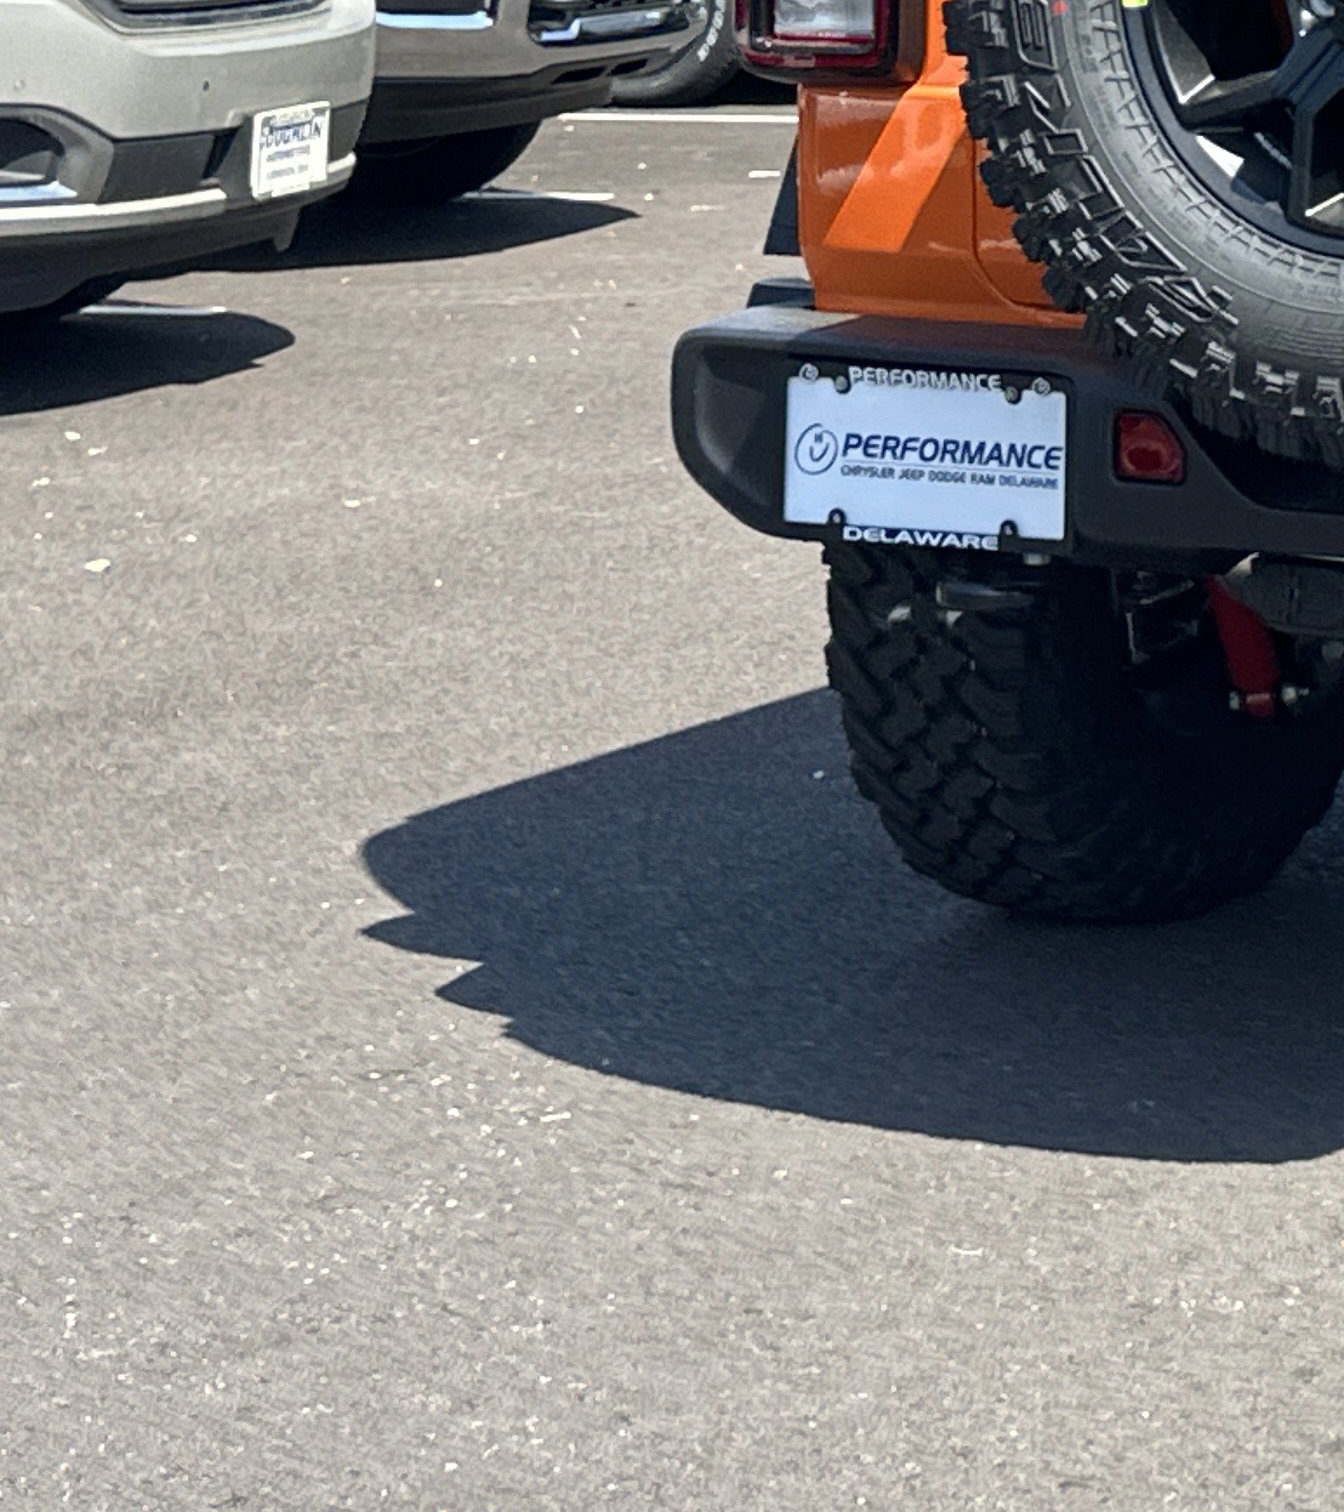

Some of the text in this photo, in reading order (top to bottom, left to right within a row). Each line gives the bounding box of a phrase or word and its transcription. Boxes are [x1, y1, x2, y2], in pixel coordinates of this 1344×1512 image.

[849, 365, 1001, 392] PERFORMANCE
[841, 432, 1063, 471] PERFORMANCE
[840, 465, 1059, 489] CHRYSLER JEEP DODGE RAM DELAWARE
[842, 525, 999, 551] DELAWARE
